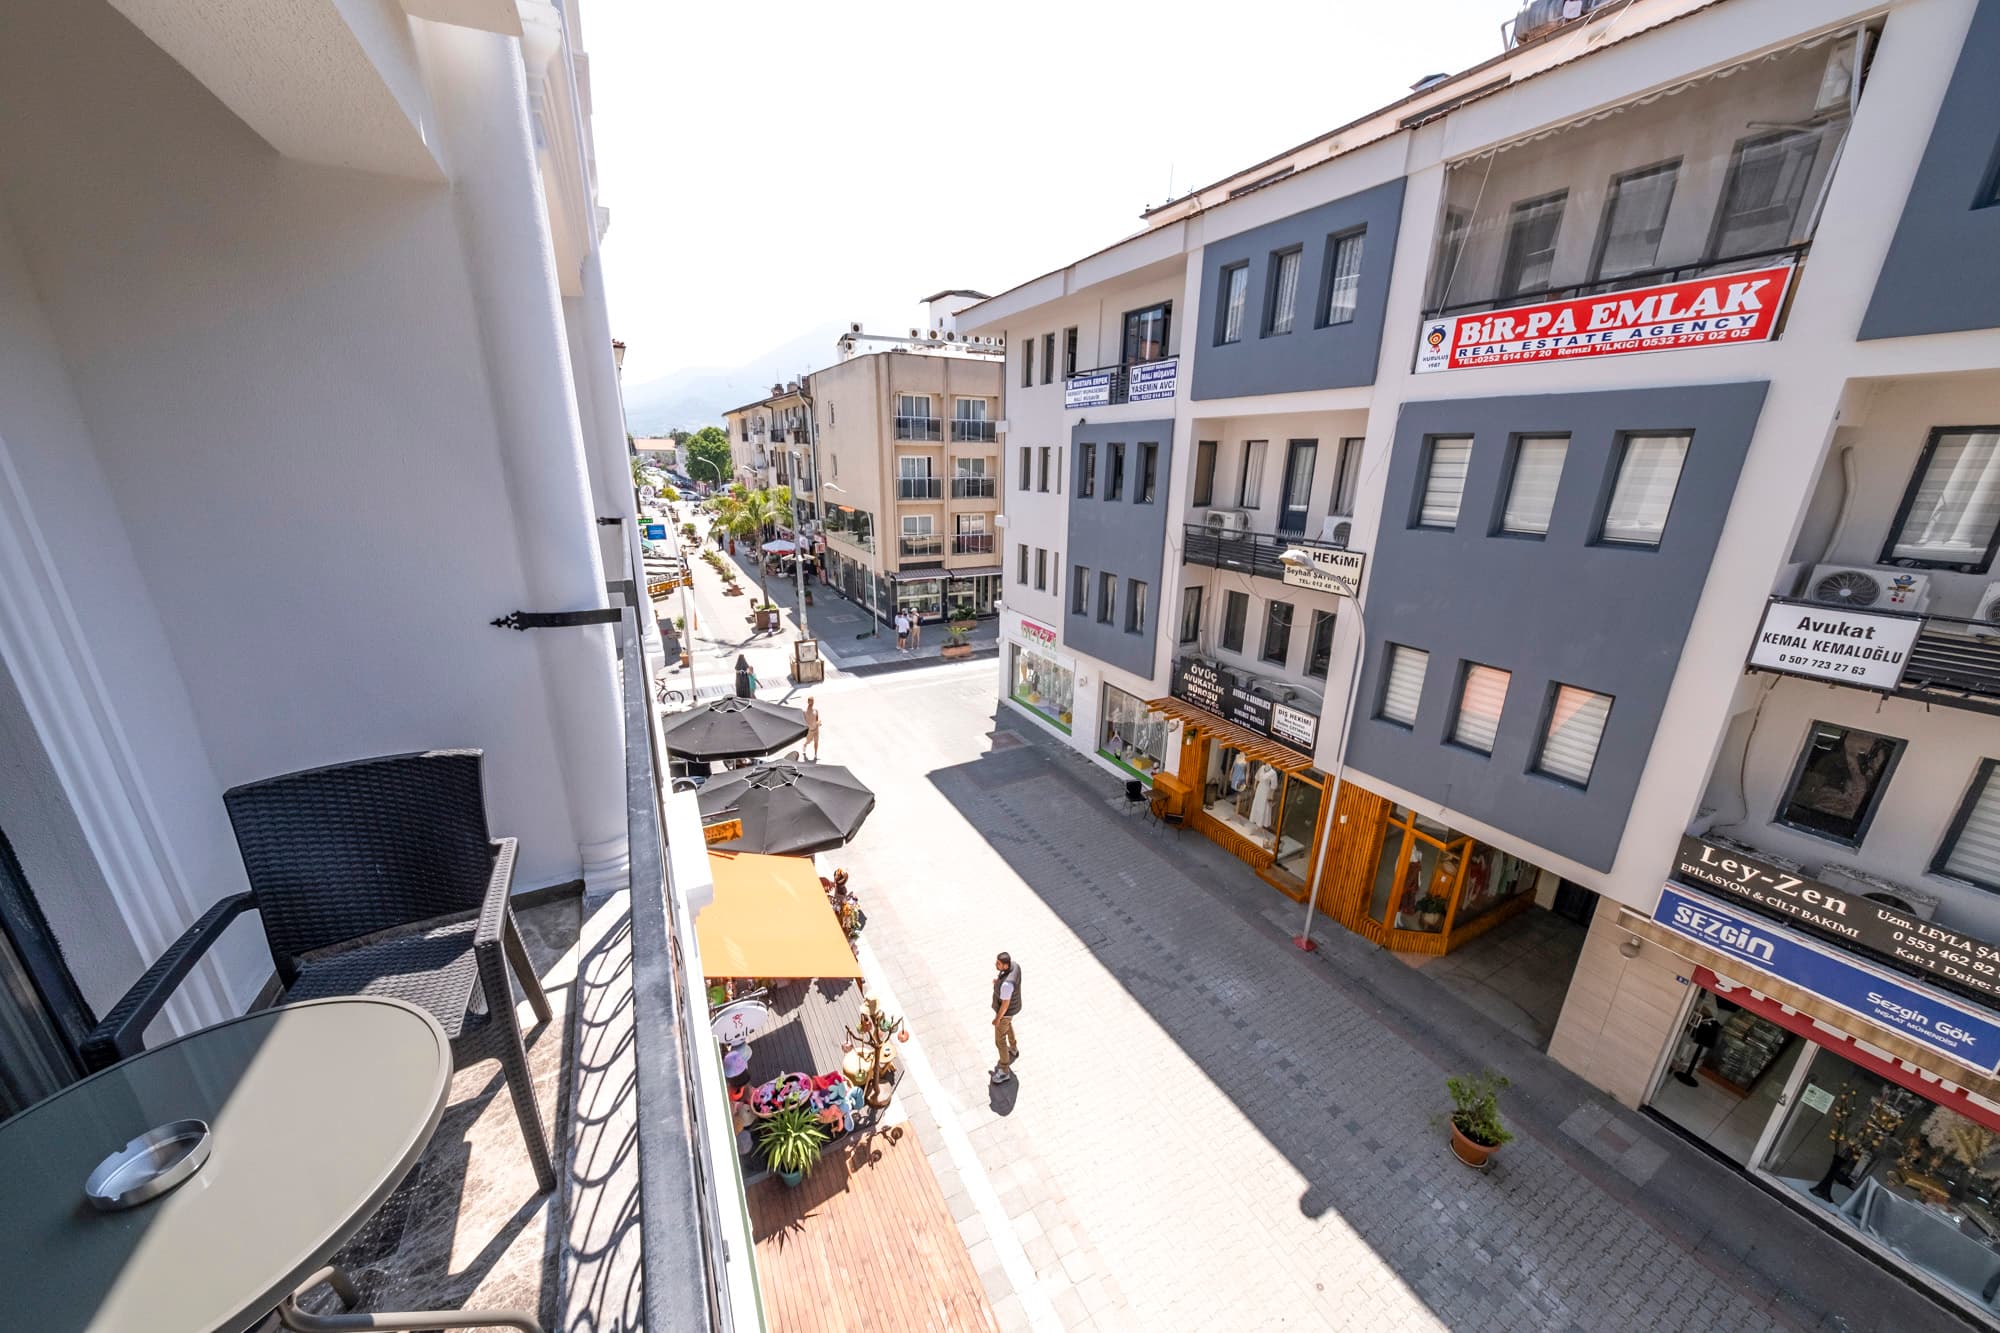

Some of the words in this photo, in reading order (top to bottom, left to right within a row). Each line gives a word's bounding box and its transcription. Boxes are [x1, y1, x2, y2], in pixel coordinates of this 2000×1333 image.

[1587, 279, 1770, 329] EMLAK
[1458, 344, 1508, 357] REAL
[1522, 332, 1613, 350] ESTATE
[1630, 315, 1755, 338] AGENCY
[1502, 352, 1521, 361] 614
[1523, 351, 1535, 359] 67
[1540, 350, 1552, 358] 20
[1557, 345, 1591, 356] Remzi
[1642, 336, 1675, 348] 0532
[1678, 333, 1704, 344] 276
[1708, 330, 1727, 340] 02
[1731, 328, 1750, 338] 05
[1762, 632, 1807, 649] KEMAL
[1812, 639, 1903, 664] KEMALOĞLU
[1797, 616, 1876, 640] Avukat
[1183, 672, 1225, 695] AVUKATLIK
[1779, 654, 1786, 662] 0
[1788, 654, 1808, 665] 507
[1812, 658, 1831, 670] 723
[1834, 662, 1849, 673] 27
[1851, 665, 1866, 676] 63
[1681, 862, 1751, 896] EPİLASYON
[1752, 892, 1764, 901] &
[1766, 895, 1800, 914] CİLT
[1801, 909, 1860, 938] BAKIMI
[1700, 845, 1847, 916] Ley-Zen
[1877, 909, 1914, 930] Uzm.
[1918, 924, 1972, 952] LEYLA
[1893, 931, 1904, 941] 0
[1905, 936, 1936, 953] 553
[1938, 949, 1970, 967] 462
[1972, 961, 1996, 977] 82
[1894, 947, 1924, 964] Kat:
[1866, 991, 1929, 1026] Sezgin
[1934, 1021, 1977, 1046] Gök
